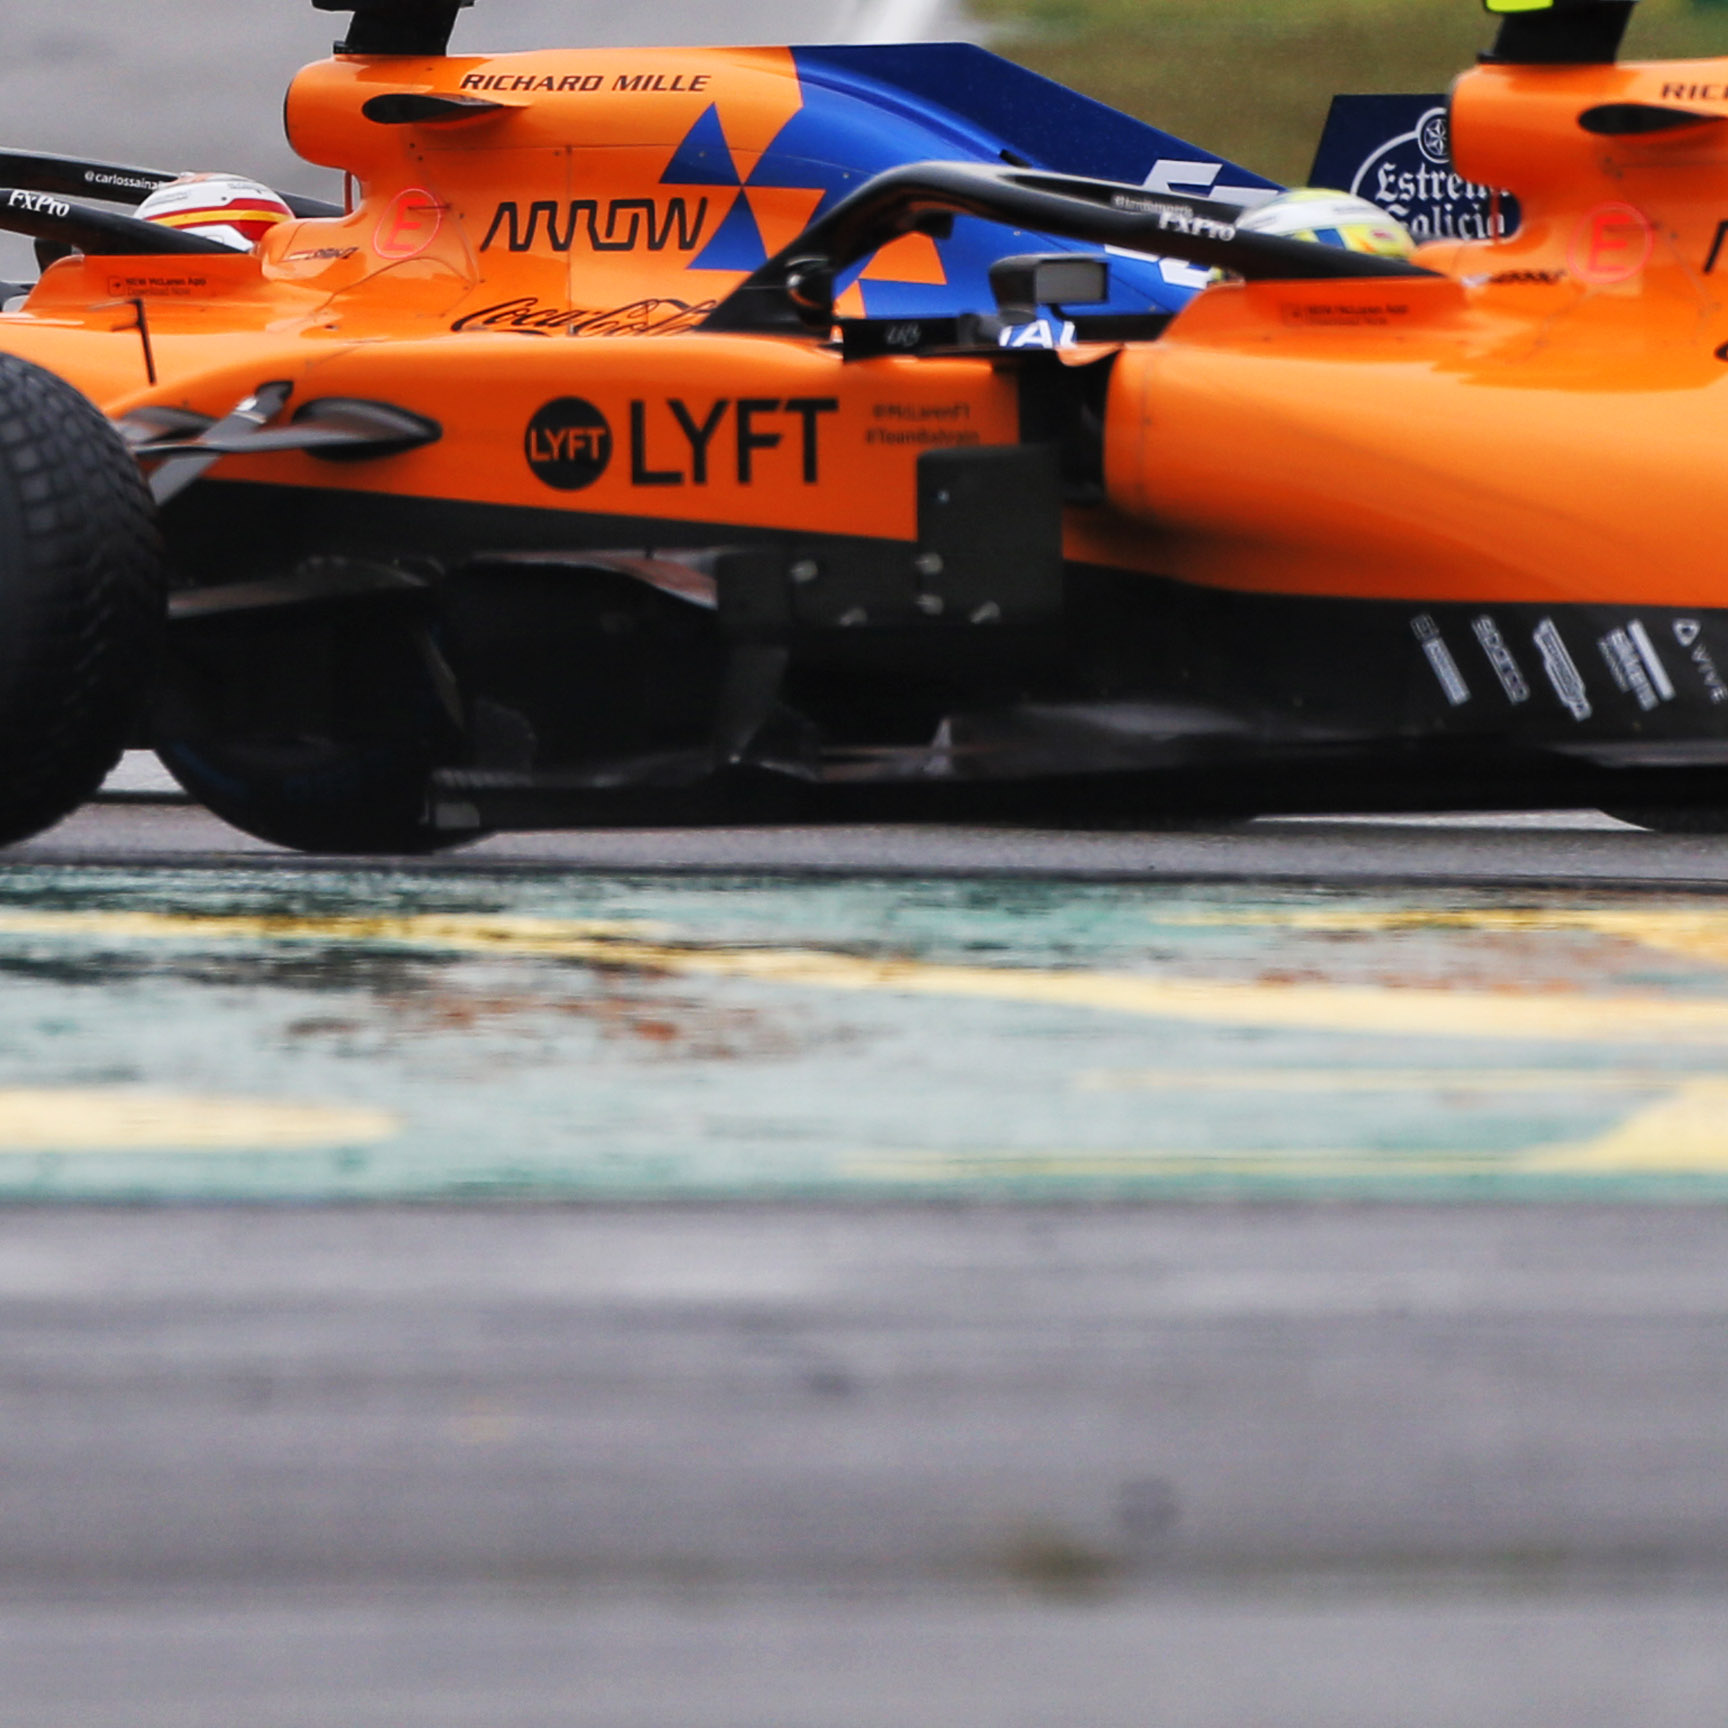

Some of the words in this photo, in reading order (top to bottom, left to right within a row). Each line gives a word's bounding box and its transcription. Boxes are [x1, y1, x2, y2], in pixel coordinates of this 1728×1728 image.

[460, 74, 604, 92] RICHARD
[612, 75, 711, 93] MILLE
[479, 197, 709, 253] ARROW
[527, 425, 606, 463] LYFT
[629, 398, 839, 486] LYFT
